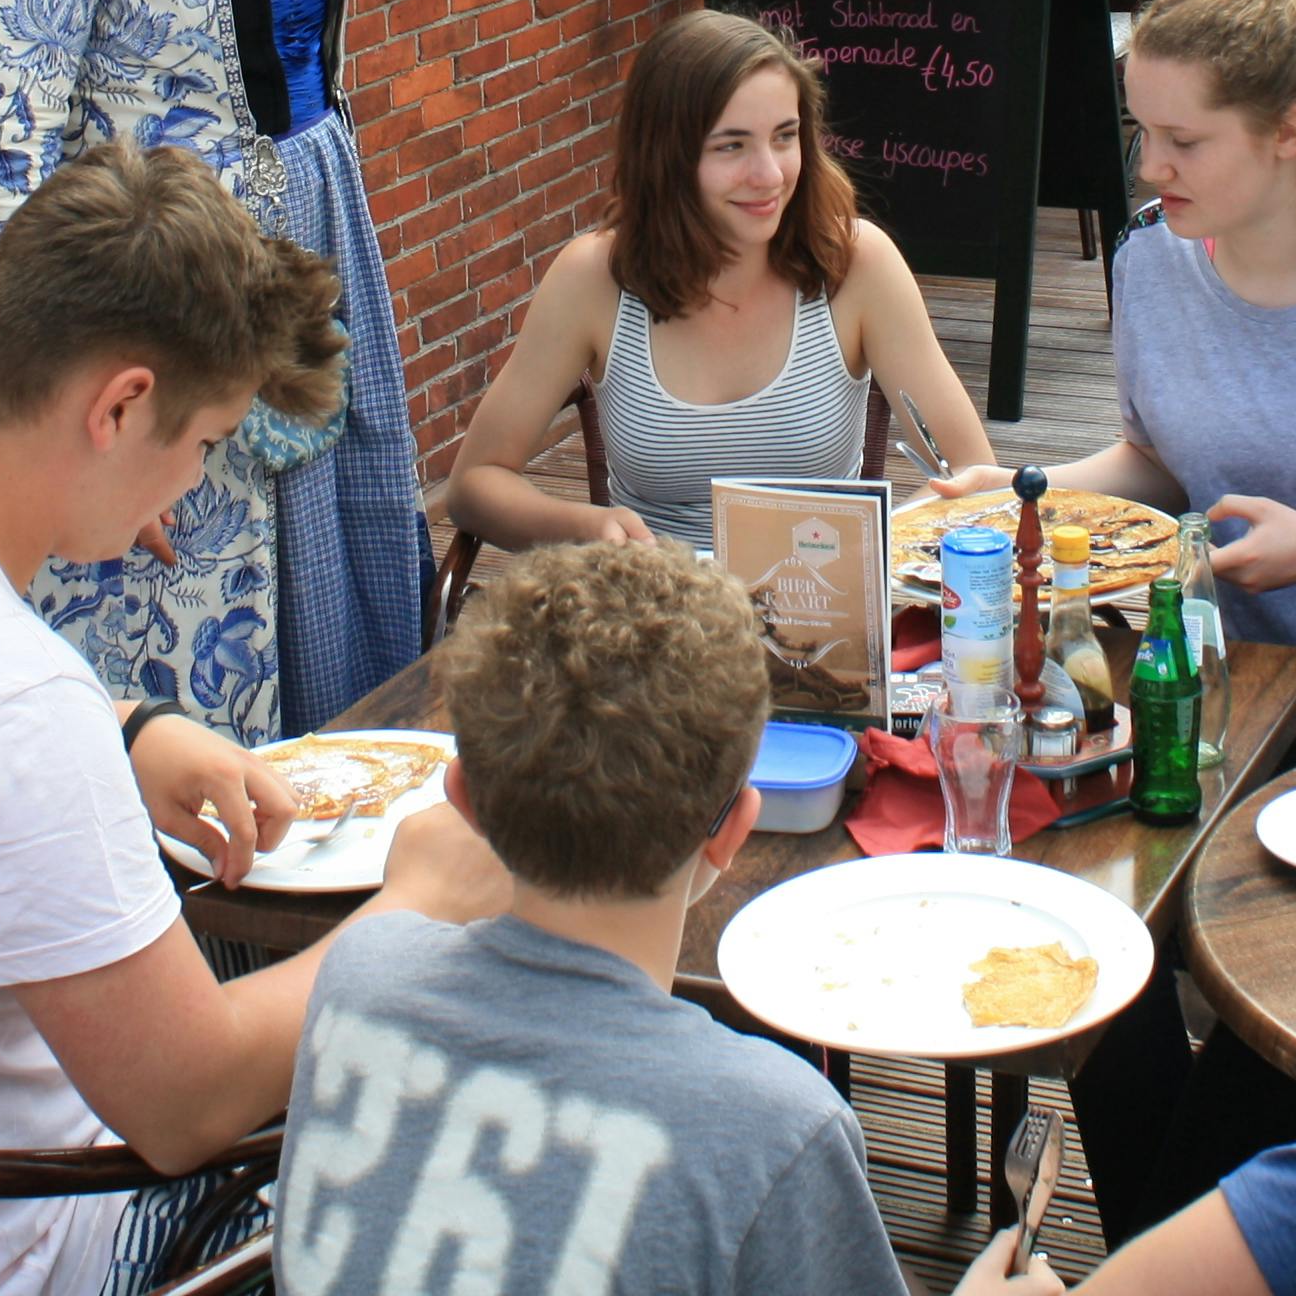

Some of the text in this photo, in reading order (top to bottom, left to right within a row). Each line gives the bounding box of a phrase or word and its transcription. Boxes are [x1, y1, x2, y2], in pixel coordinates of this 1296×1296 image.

[758, 0, 982, 35] met Stokbrood en
[793, 36, 918, 76] Tapenade
[777, 577, 818, 595] BIER
[764, 591, 832, 611] KAART
